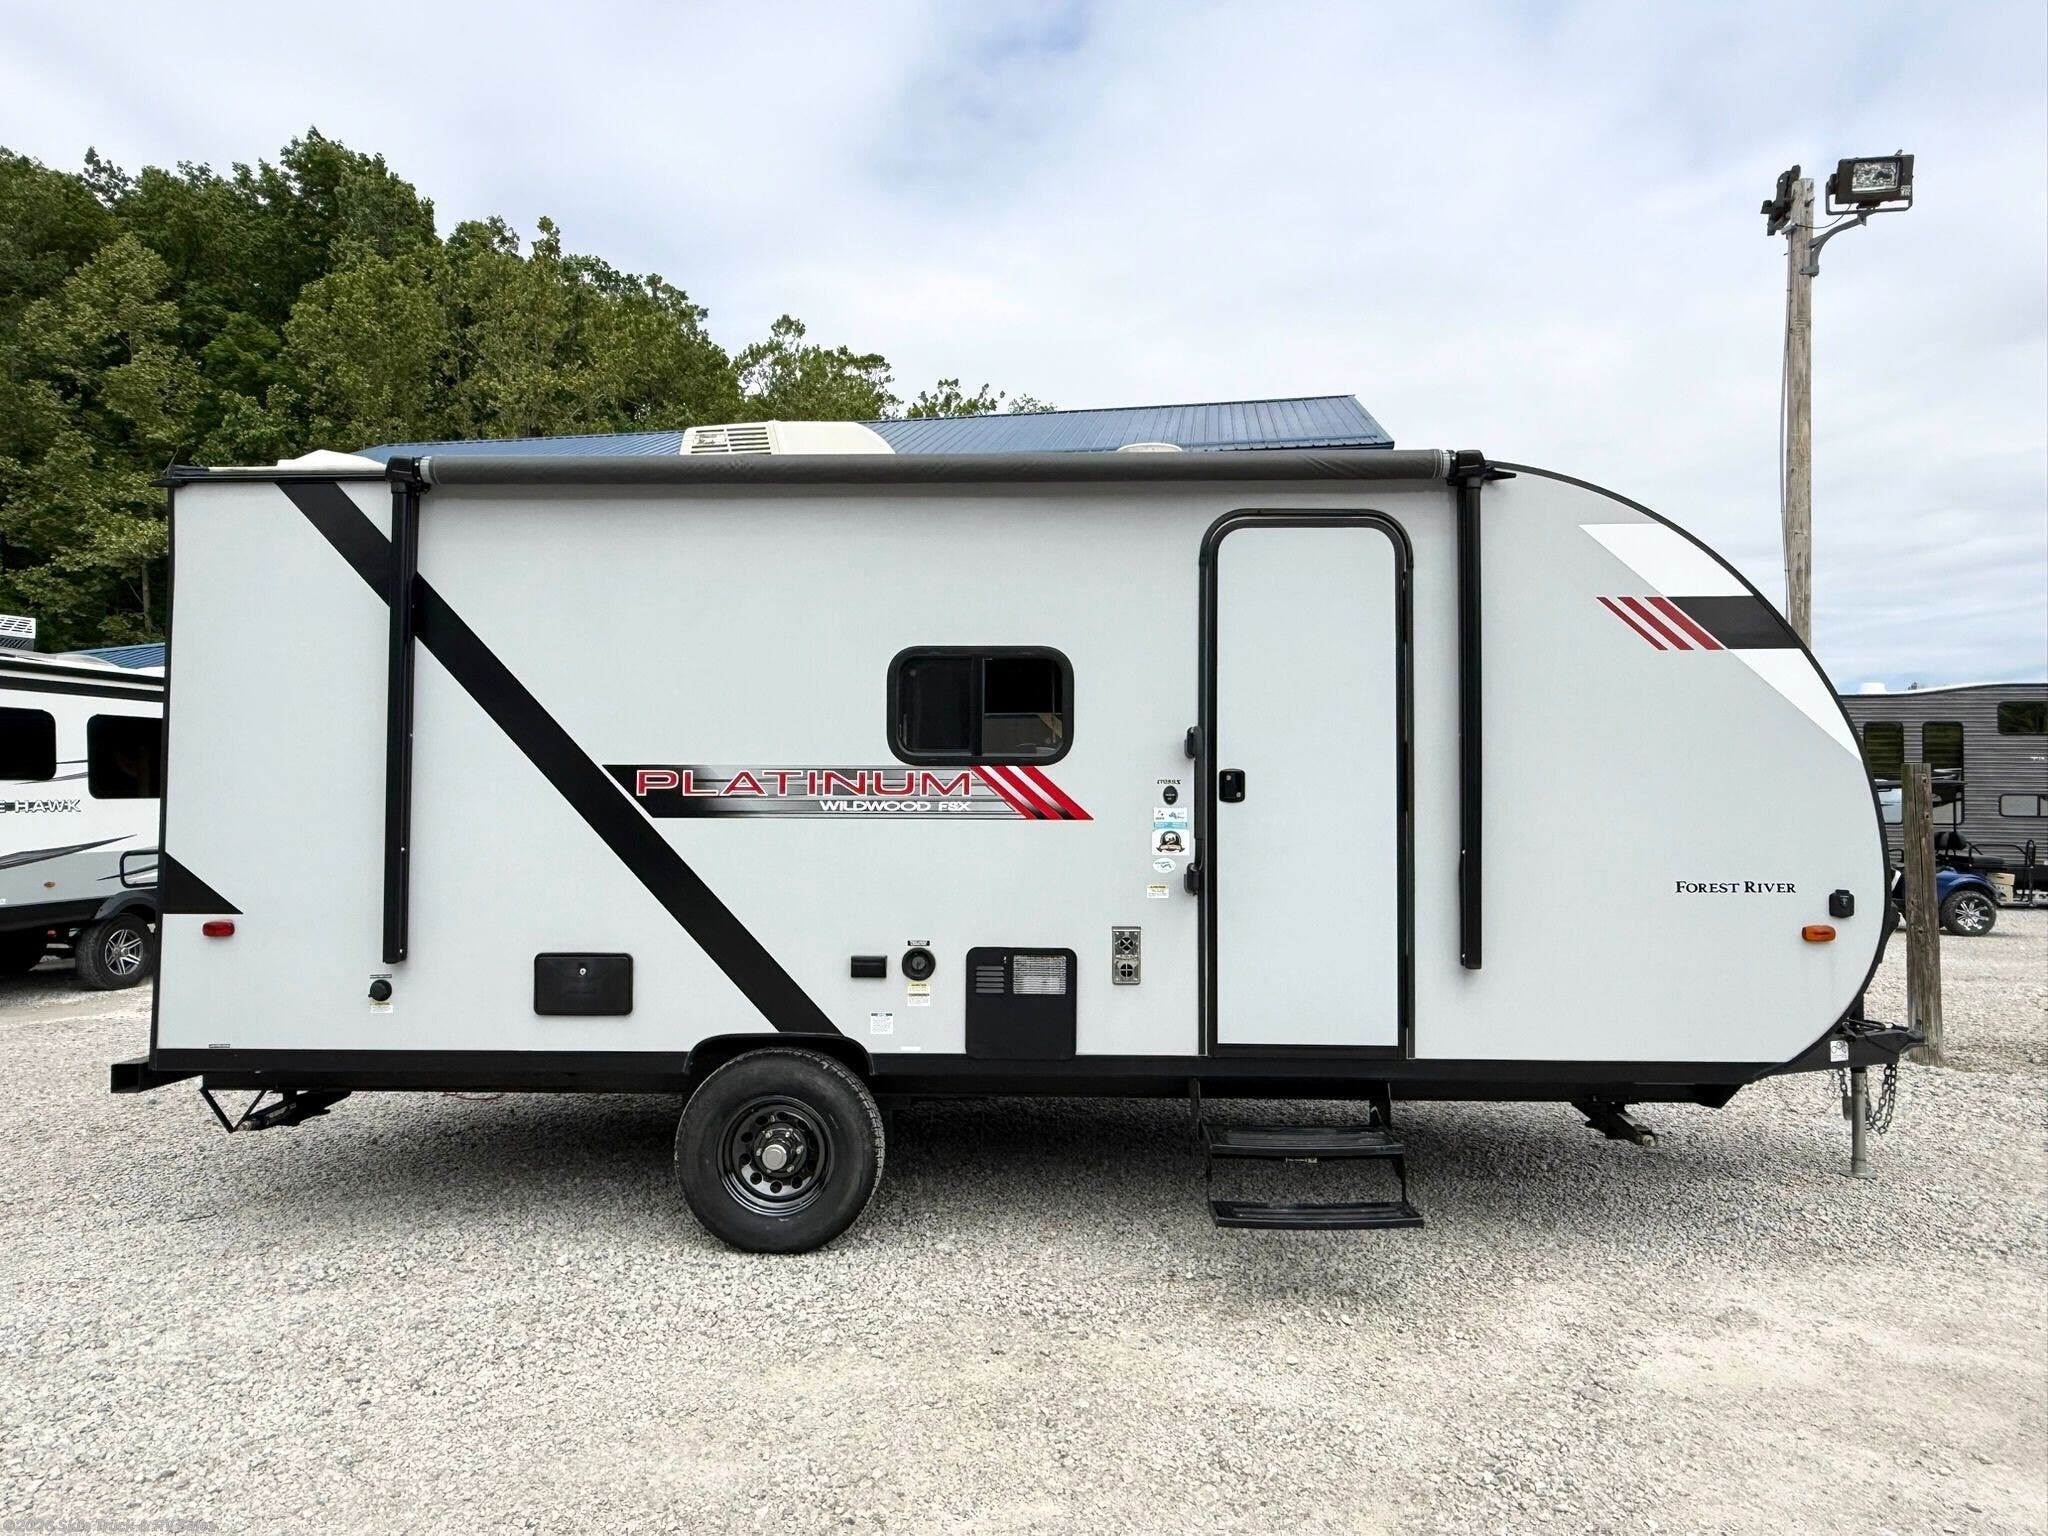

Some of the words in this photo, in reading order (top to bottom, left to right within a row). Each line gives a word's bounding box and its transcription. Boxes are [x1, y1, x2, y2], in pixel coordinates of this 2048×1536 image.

[635, 769, 973, 797] PLATINUM
[15, 799, 81, 813] HAWK
[819, 799, 931, 812] WILDWOOD
[938, 800, 972, 812] FSX
